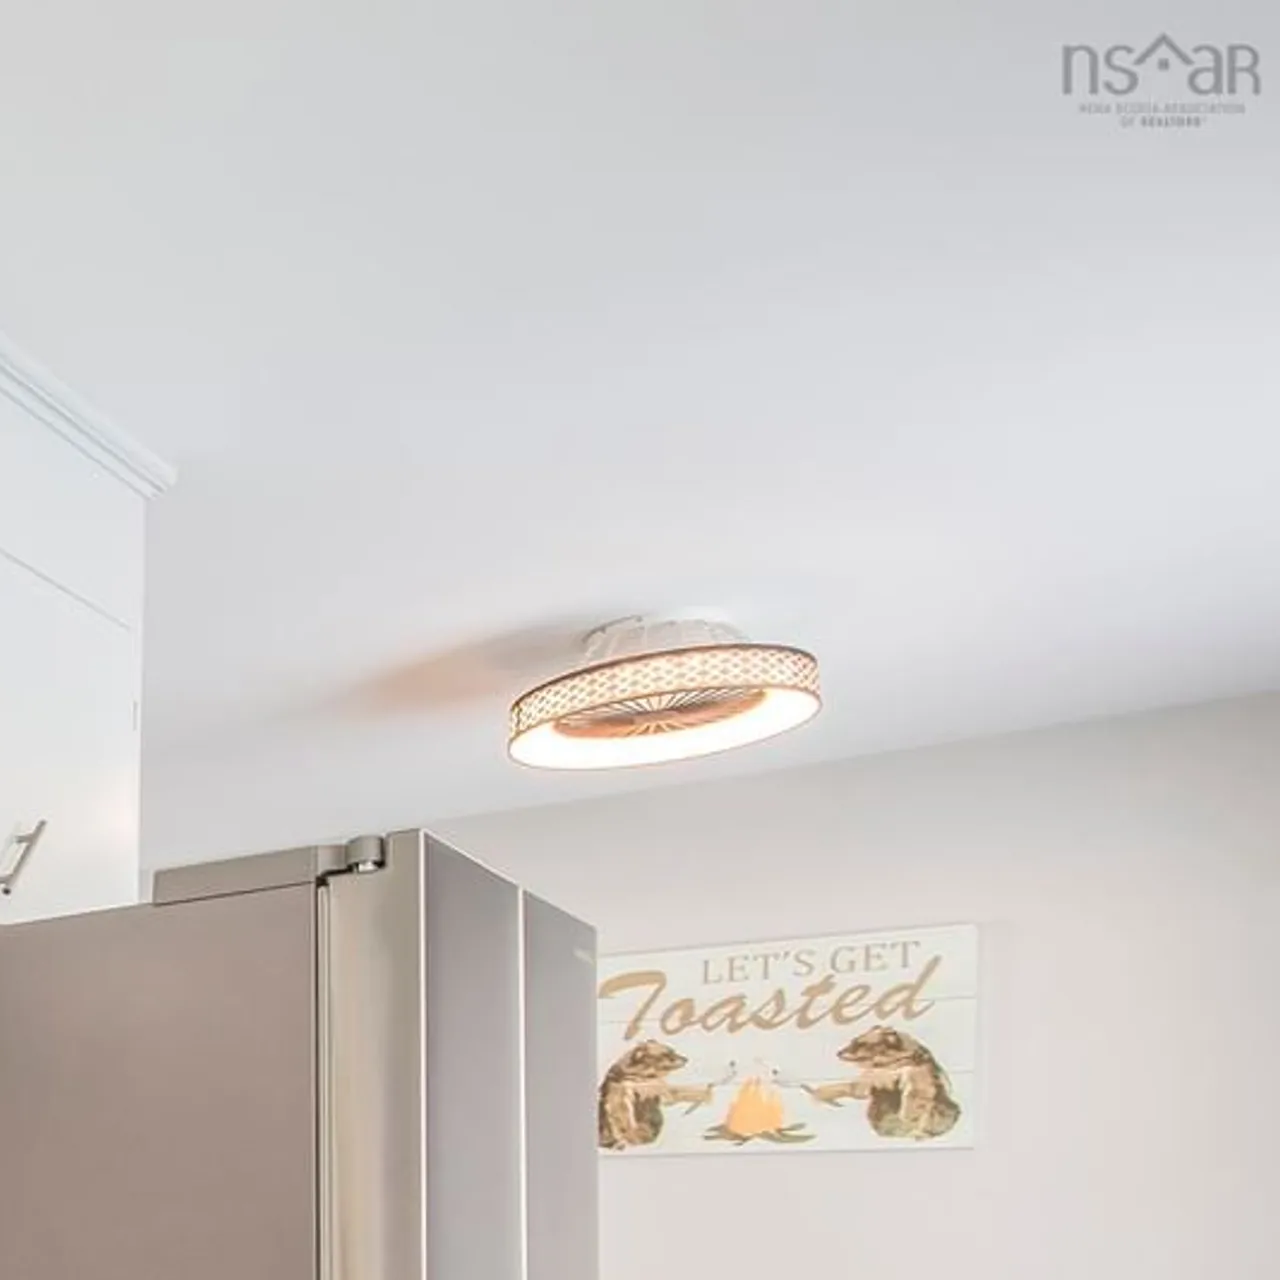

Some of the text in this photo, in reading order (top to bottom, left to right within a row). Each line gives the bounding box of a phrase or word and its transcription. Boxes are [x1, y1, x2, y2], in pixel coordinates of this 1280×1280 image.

[702, 940, 921, 985] LET'S GET
[598, 955, 942, 1041] Toasted
